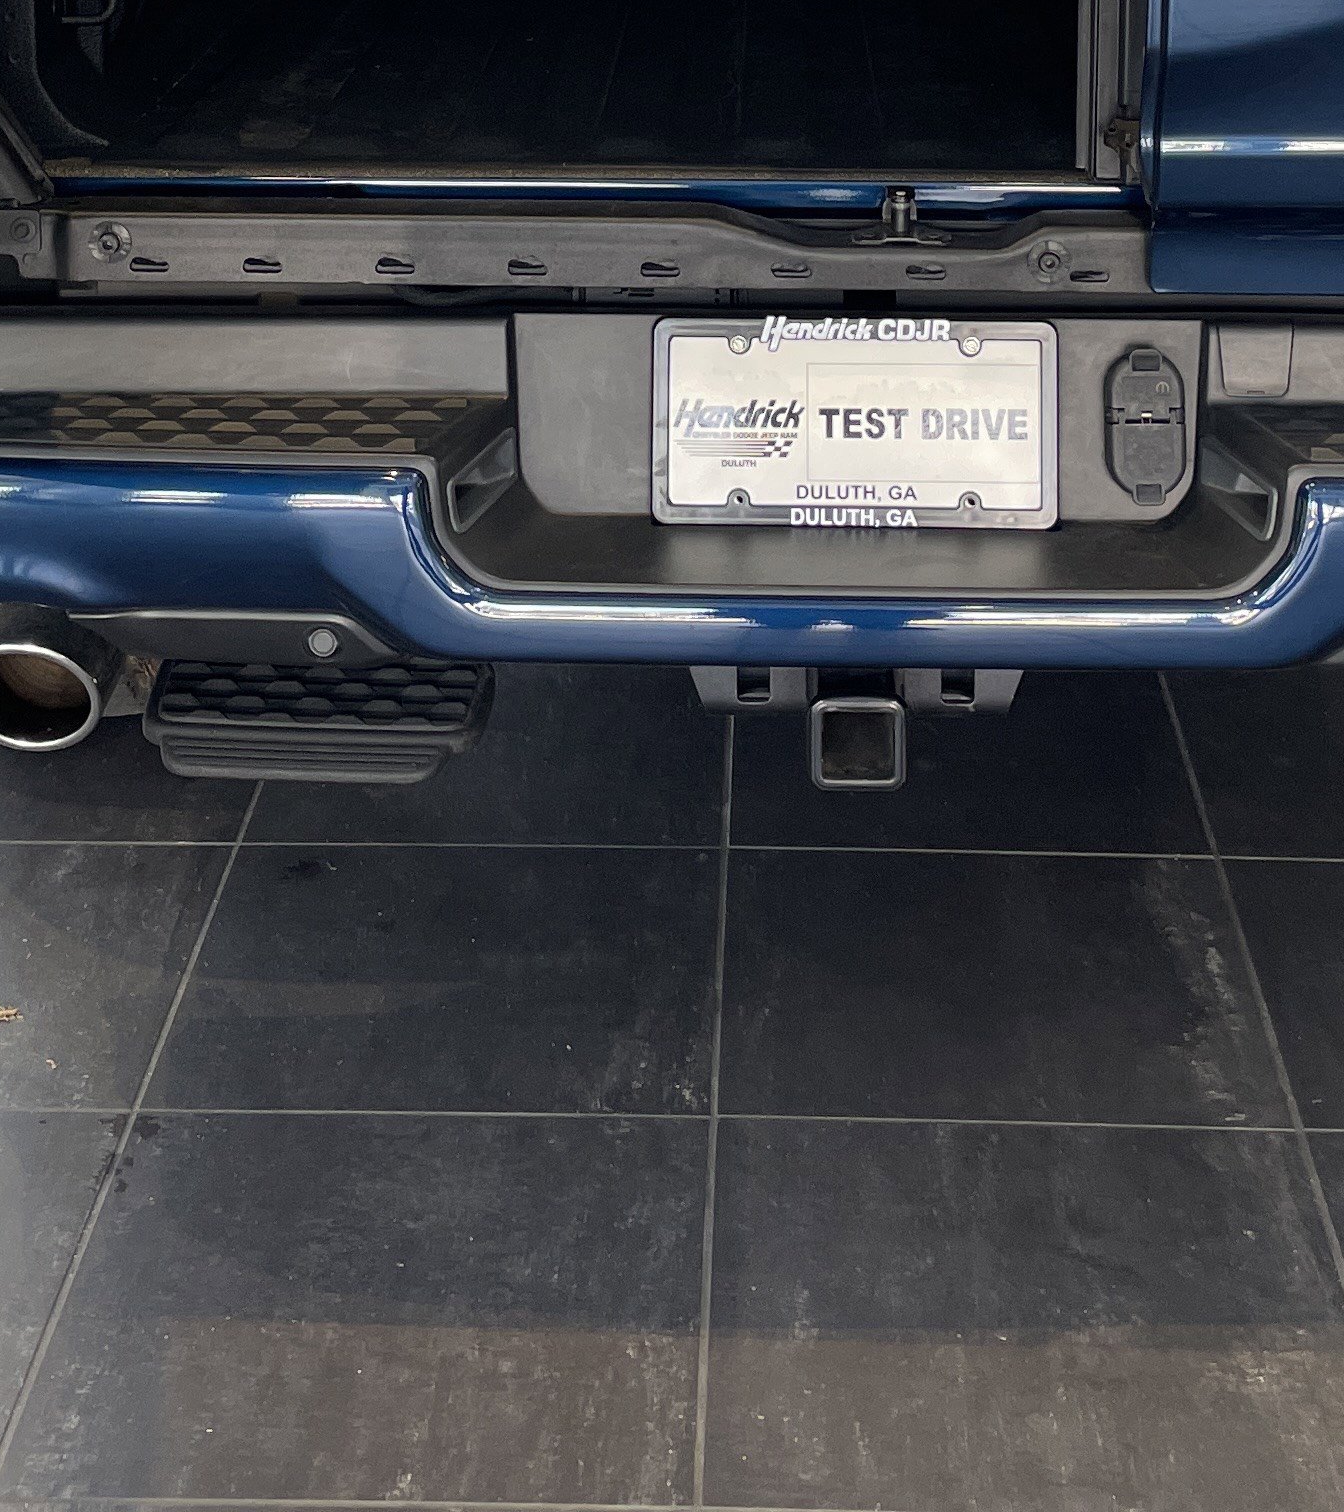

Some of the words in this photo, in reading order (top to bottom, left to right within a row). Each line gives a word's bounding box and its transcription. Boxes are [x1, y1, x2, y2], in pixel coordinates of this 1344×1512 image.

[759, 315, 874, 352] Hendrick
[877, 319, 951, 341] CDJR
[673, 399, 805, 438] Hendrick
[818, 408, 909, 439] TEST
[921, 408, 1029, 440] DRIVE
[721, 459, 757, 468] DULUTH
[796, 485, 881, 502] DULUTH,
[888, 485, 917, 500] GA
[790, 508, 880, 527] DULUTH,
[886, 509, 918, 527] GA
